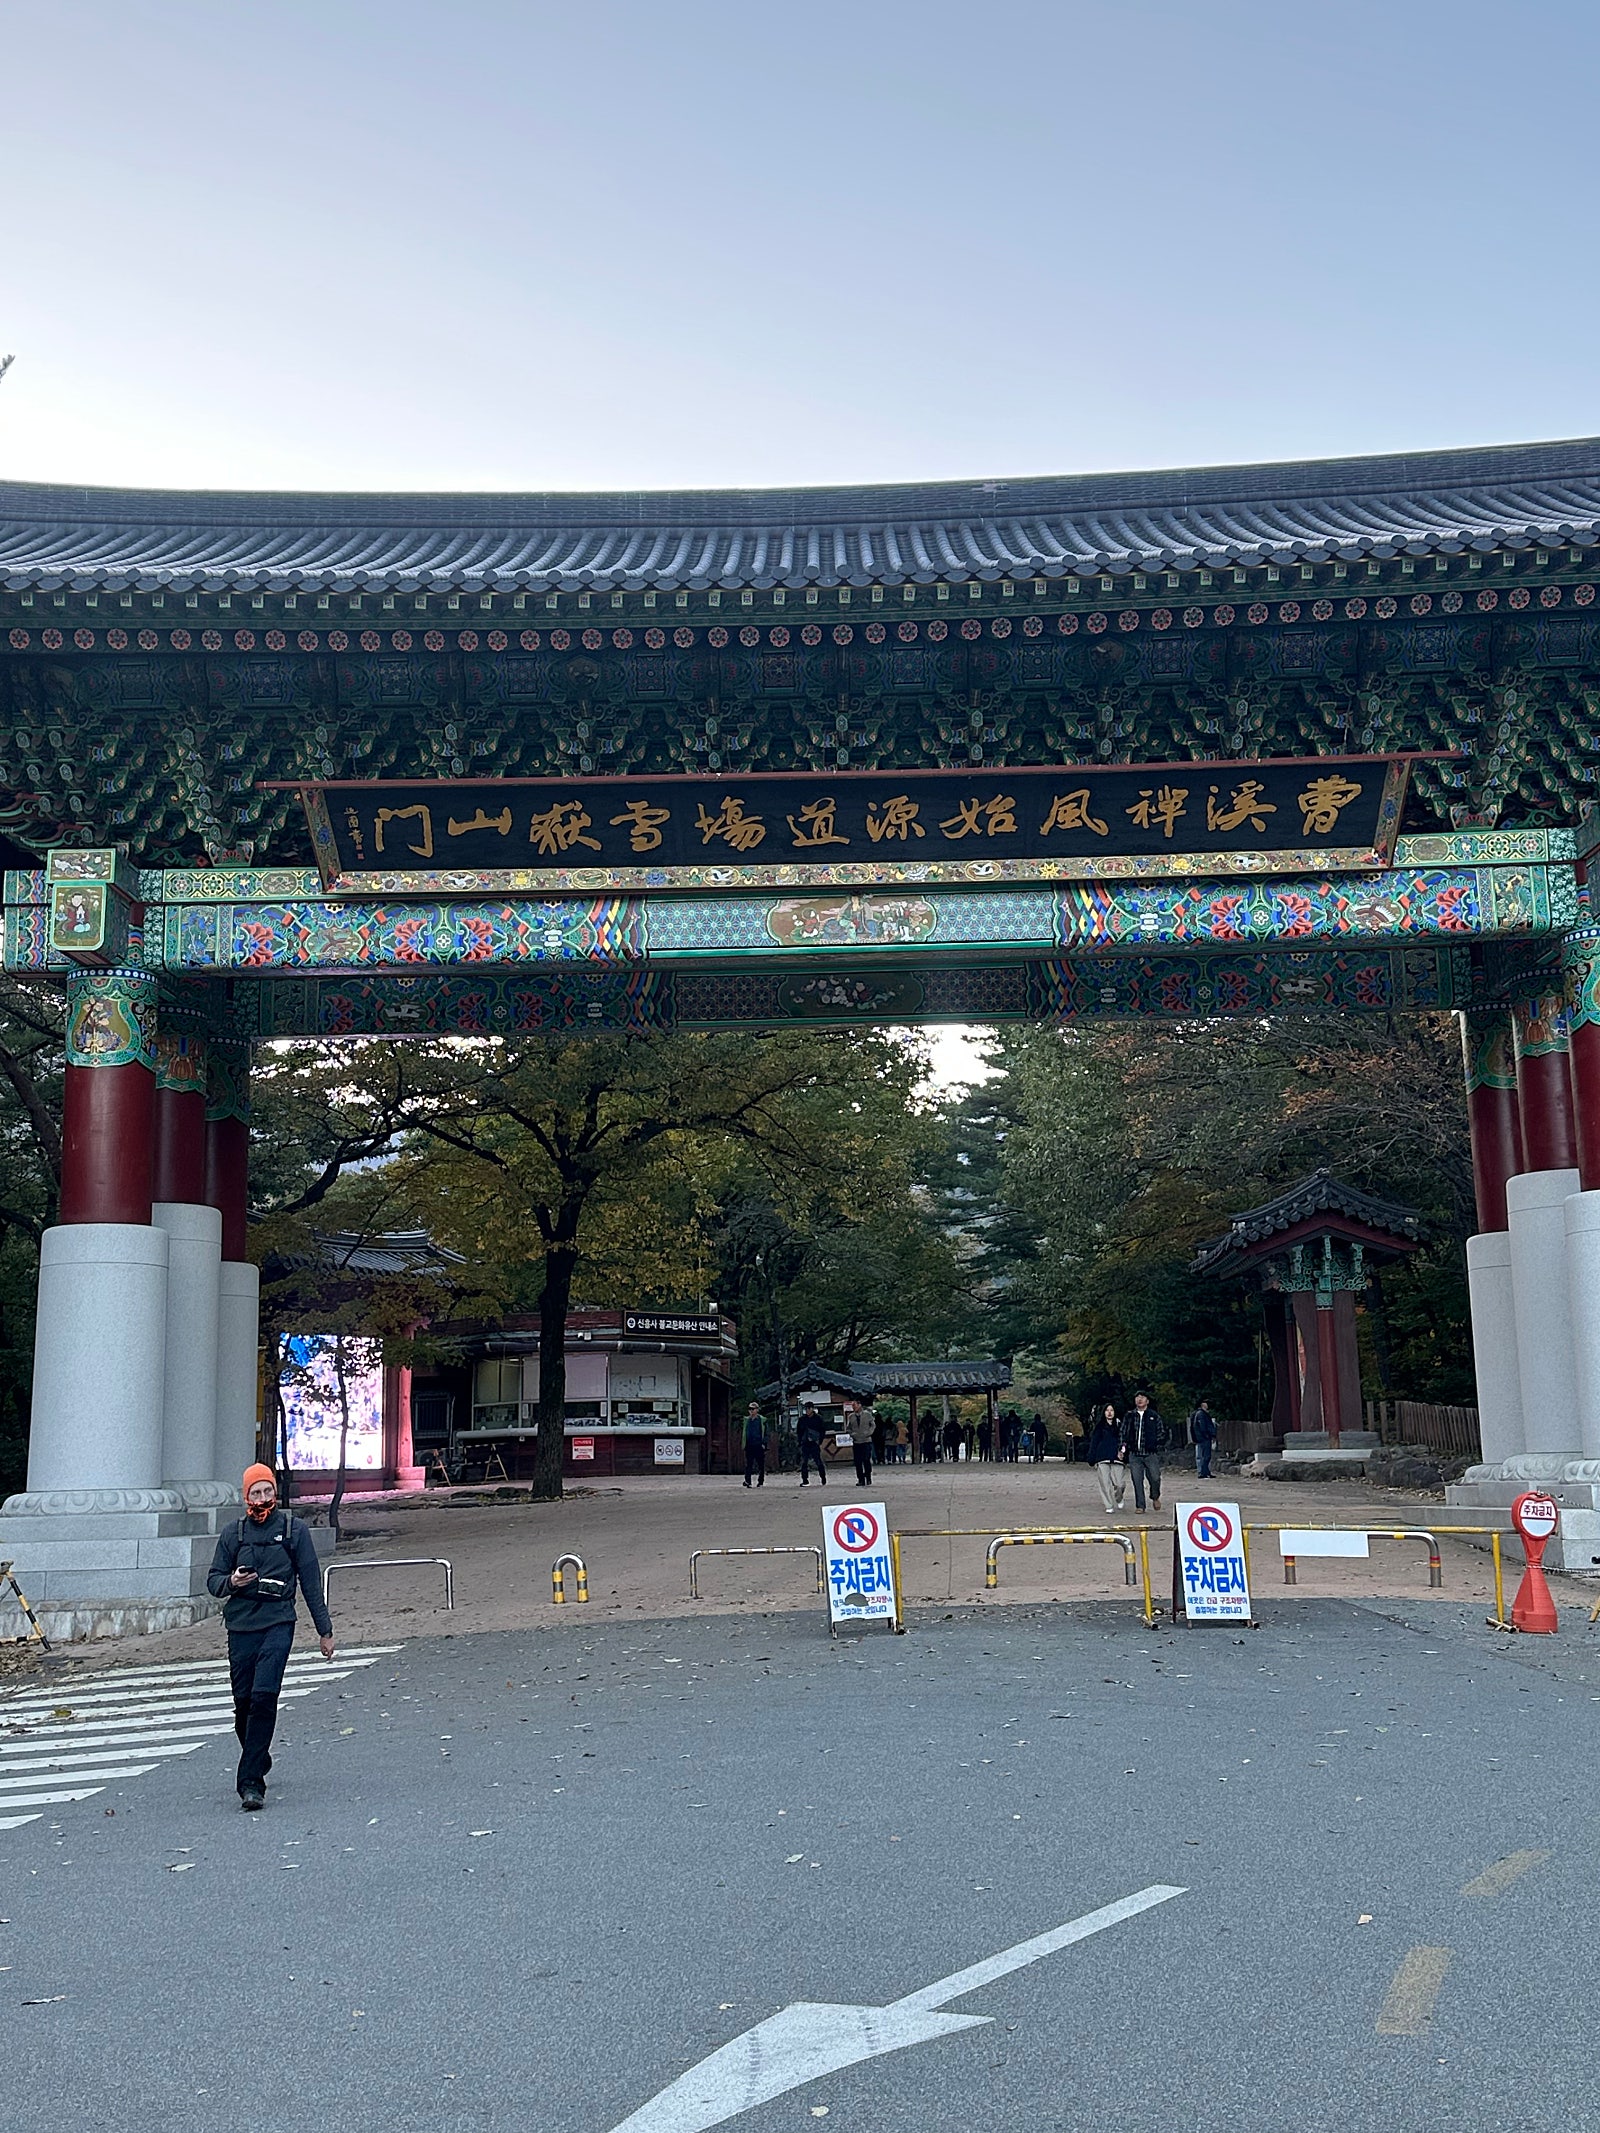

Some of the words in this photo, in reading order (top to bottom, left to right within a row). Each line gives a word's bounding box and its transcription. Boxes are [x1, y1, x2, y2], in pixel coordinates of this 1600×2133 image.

[637, 1318, 657, 1330] 신흥사
[699, 1321, 719, 1331] 안내소
[1523, 1504, 1553, 1517] 주차금지
[829, 1555, 891, 1595] 주차금지
[1184, 1556, 1246, 1593] 주차금지
